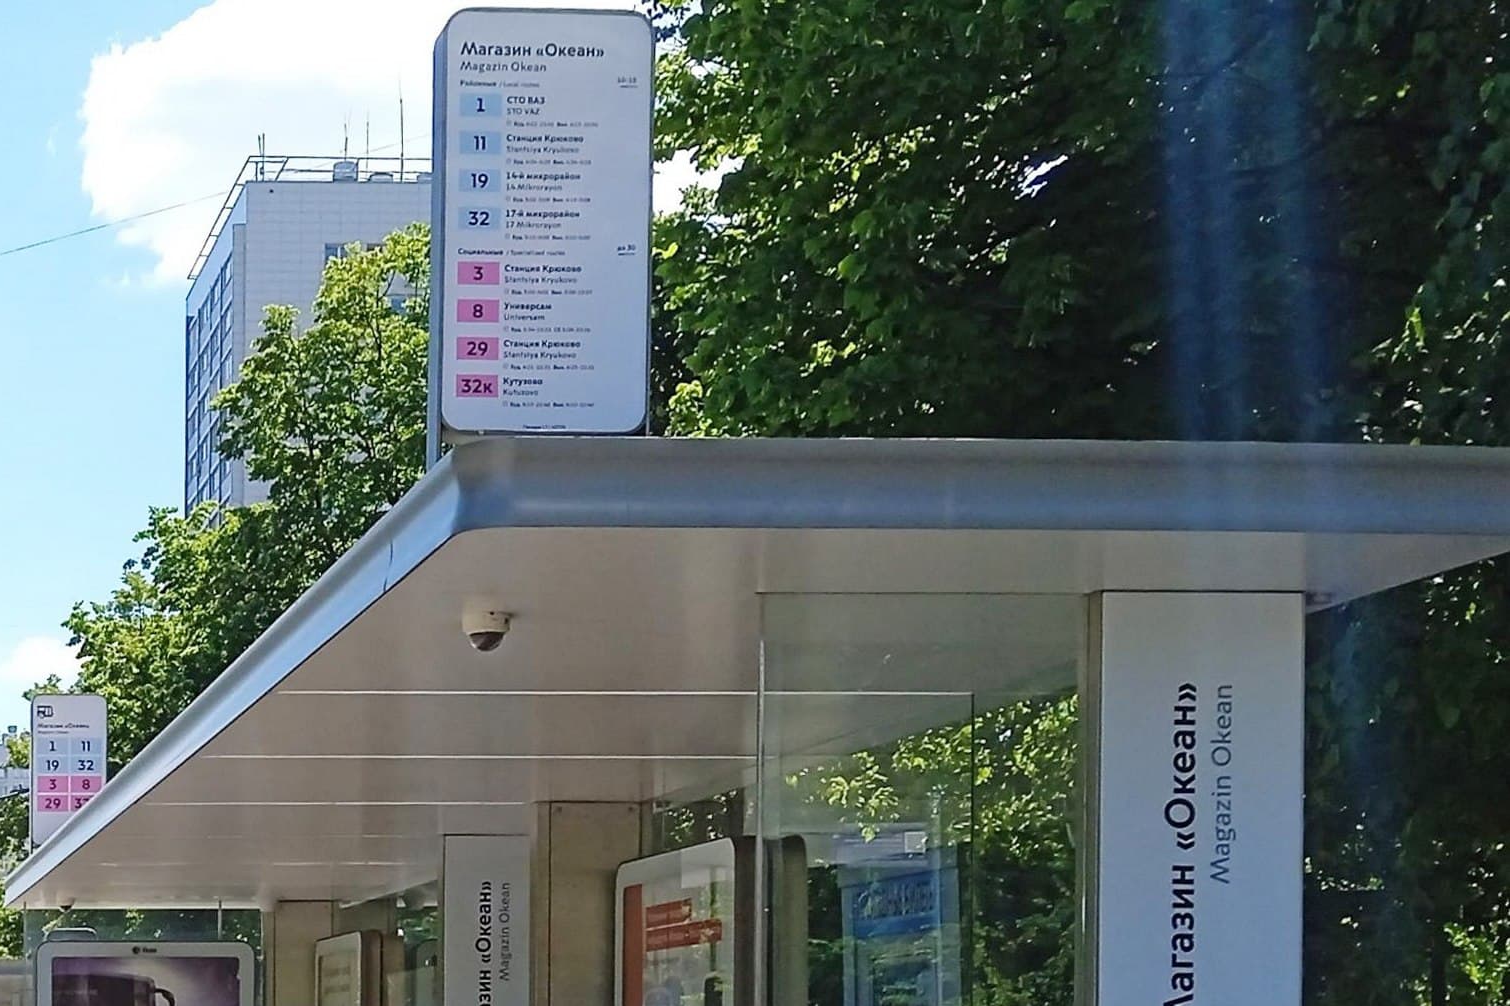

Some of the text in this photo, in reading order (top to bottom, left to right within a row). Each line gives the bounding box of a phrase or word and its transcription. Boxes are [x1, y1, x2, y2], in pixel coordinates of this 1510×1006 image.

[460, 41, 604, 58] Магазин «Океан»
[460, 61, 547, 73] Magazin Okean
[476, 98, 486, 112] 1
[506, 96, 526, 105] СТО
[474, 136, 486, 150] 11
[506, 134, 584, 146] Станция Крюково
[471, 173, 489, 188] 19
[526, 172, 581, 183] микрорайон
[468, 211, 490, 226] 32
[526, 210, 580, 220] микрорайон
[474, 266, 484, 281] 3
[504, 264, 582, 275] Станция Крюково
[473, 304, 484, 318] 8
[504, 302, 552, 312] Универсам
[466, 342, 488, 356] 29
[504, 340, 582, 350] Станция Крюково
[503, 378, 543, 388] Кутузово
[50, 741, 90, 752] 1 11
[46, 760, 94, 771] 19 32
[1164, 682, 1198, 851] «Океан»
[50, 778, 90, 790] 3 8
[1210, 684, 1236, 884] Magazin Okean
[45, 798, 61, 809] 29
[475, 880, 492, 964] «Океан»
[499, 882, 512, 982] Magazin Okean
